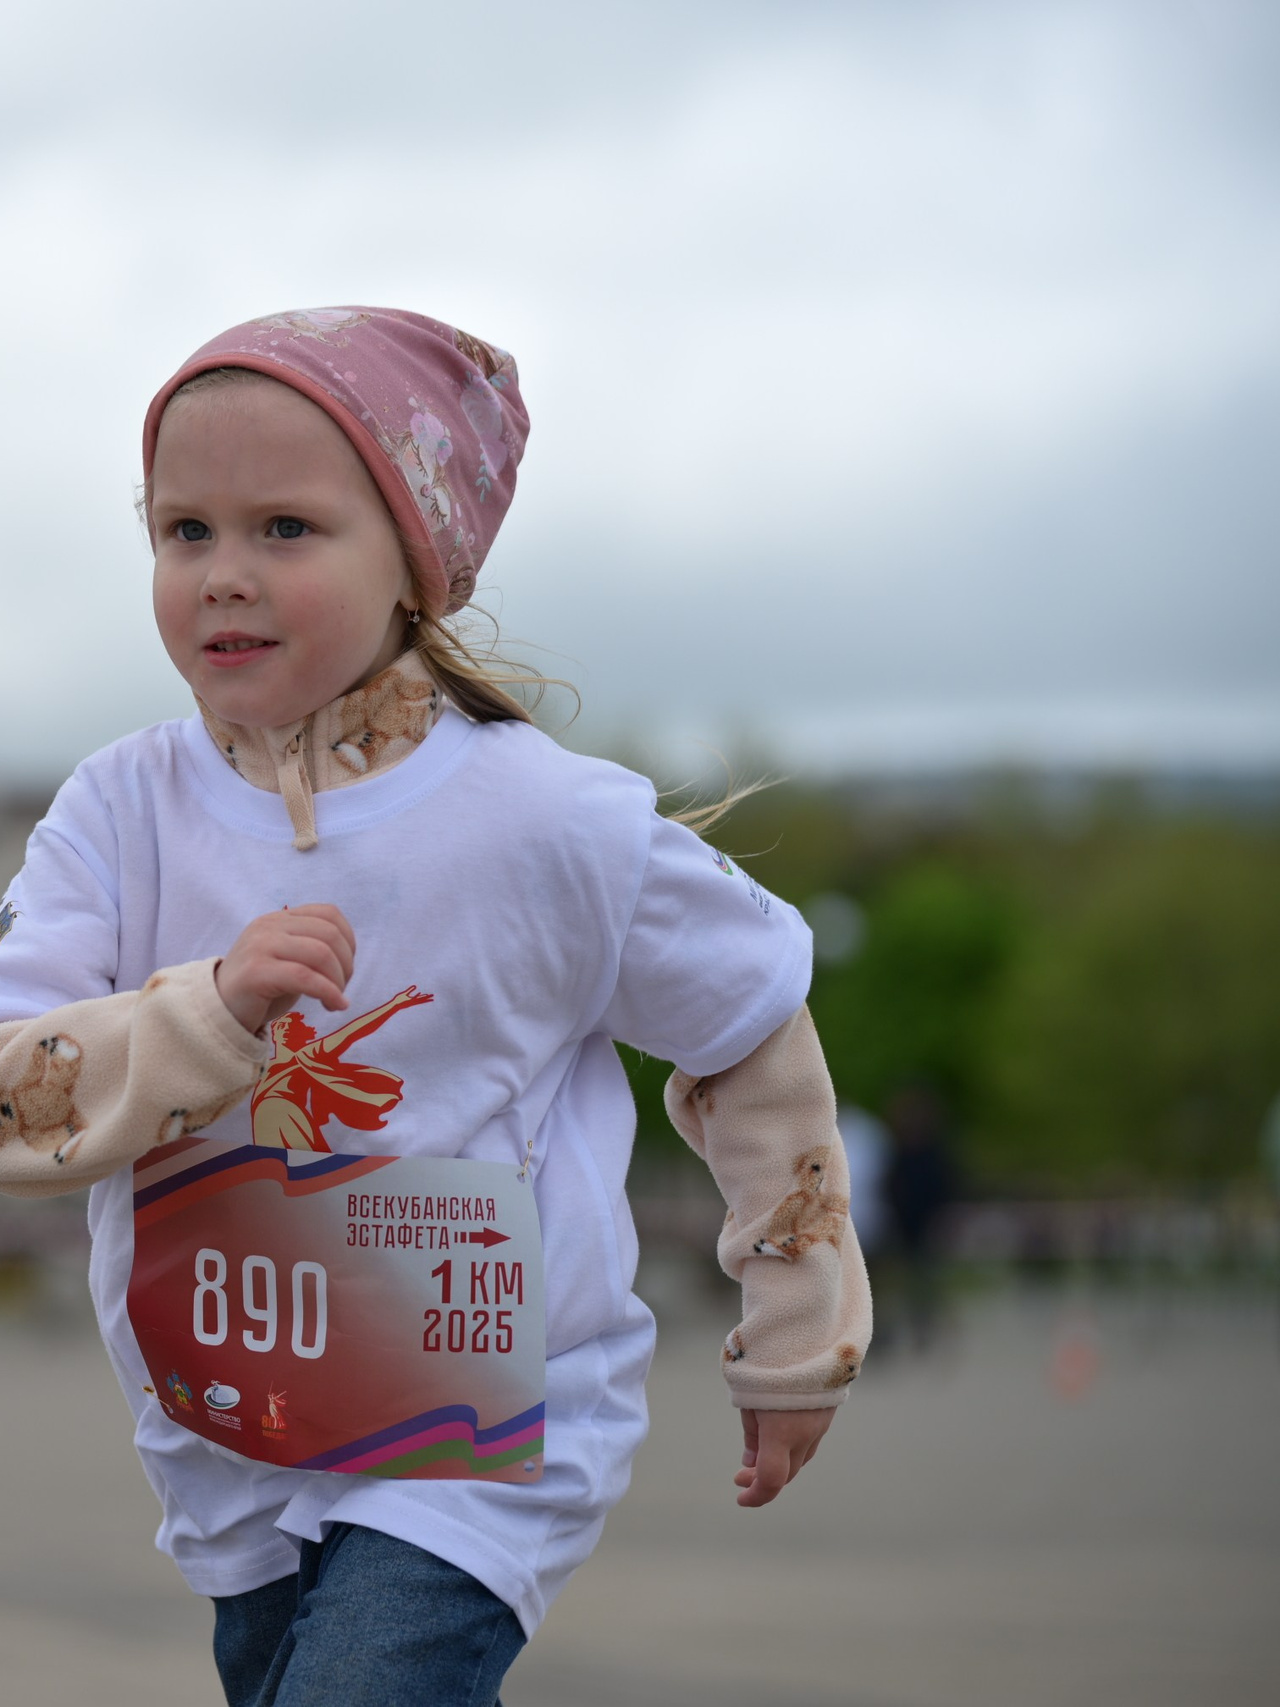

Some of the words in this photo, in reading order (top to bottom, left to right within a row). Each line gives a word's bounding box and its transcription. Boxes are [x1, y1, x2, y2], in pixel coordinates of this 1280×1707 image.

[347, 1193, 496, 1222] ВСЕКУБАНСКАЯ
[347, 1222, 450, 1250] ЭСТАФЕТА
[193, 1247, 328, 1360] 890
[431, 1259, 452, 1305] 1
[470, 1261, 524, 1306] КМ
[422, 1308, 513, 1354] 2025
